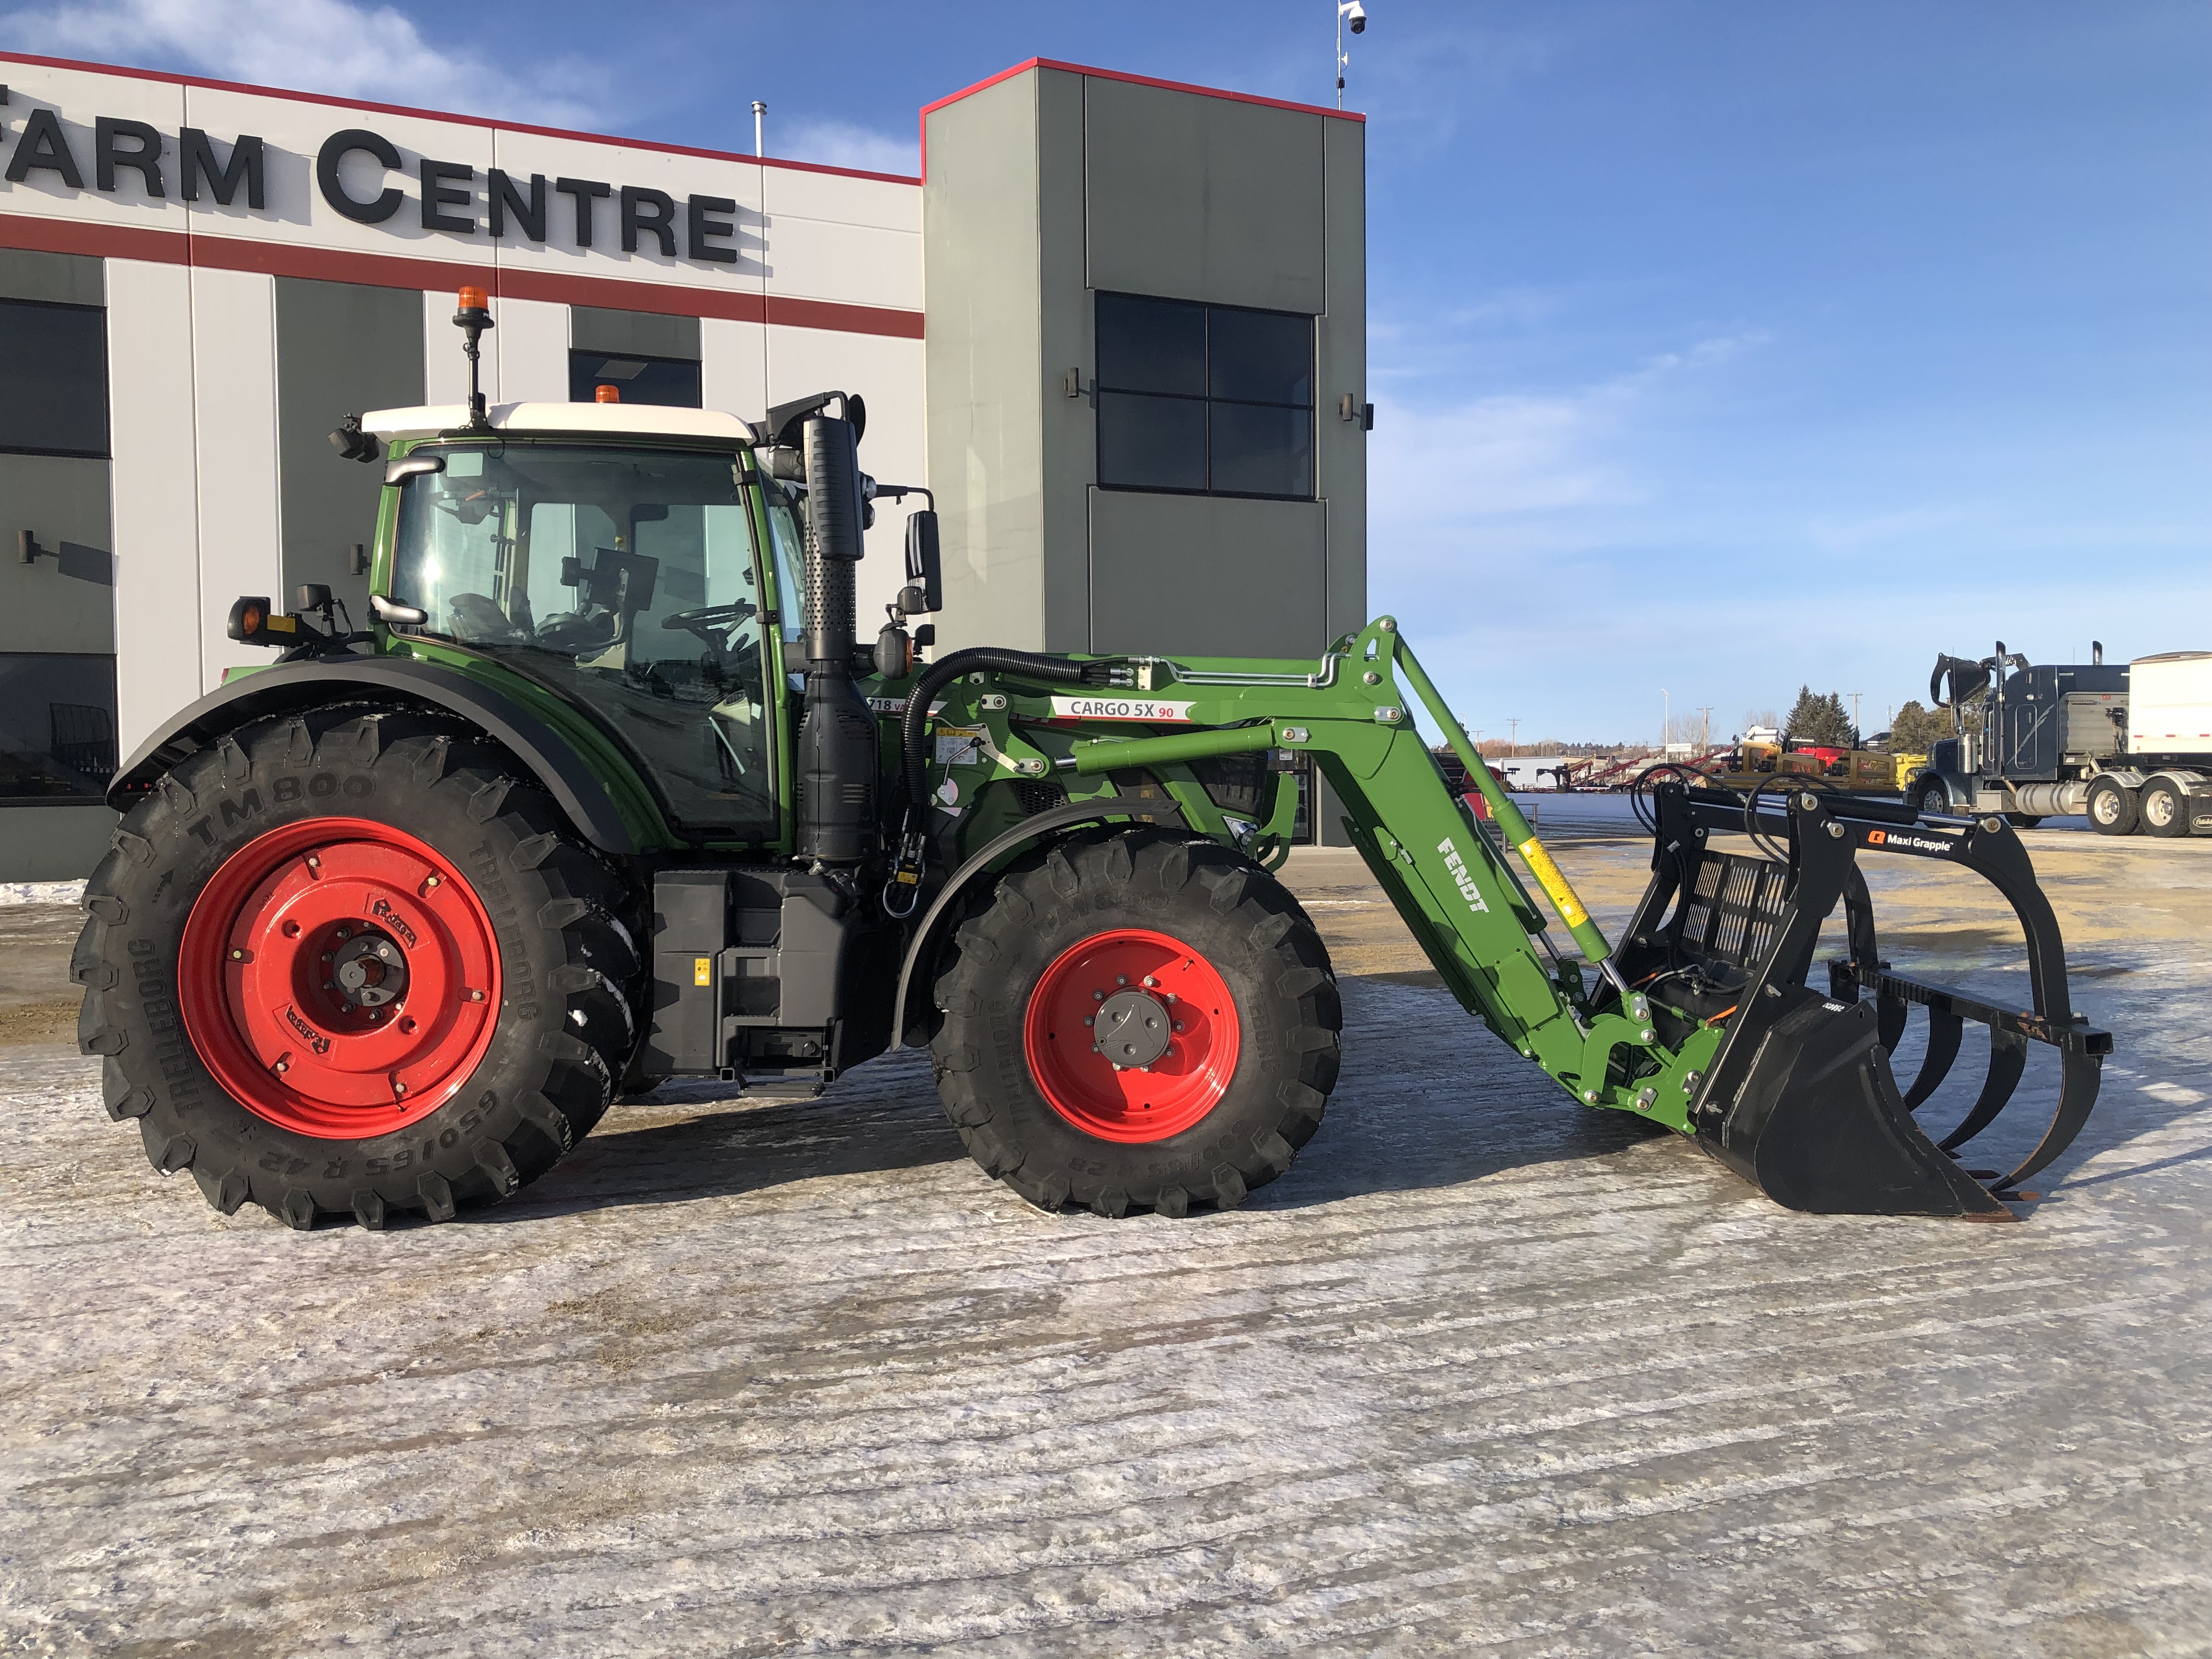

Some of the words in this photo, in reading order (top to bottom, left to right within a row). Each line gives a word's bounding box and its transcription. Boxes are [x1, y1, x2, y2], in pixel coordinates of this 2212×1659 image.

[0, 84, 265, 210] ARM
[868, 699, 891, 710] 718
[1070, 701, 1130, 716] CARGO
[1134, 704, 1155, 717] 5X
[1159, 708, 1174, 718] 90
[1437, 837, 1489, 913] FENDT
